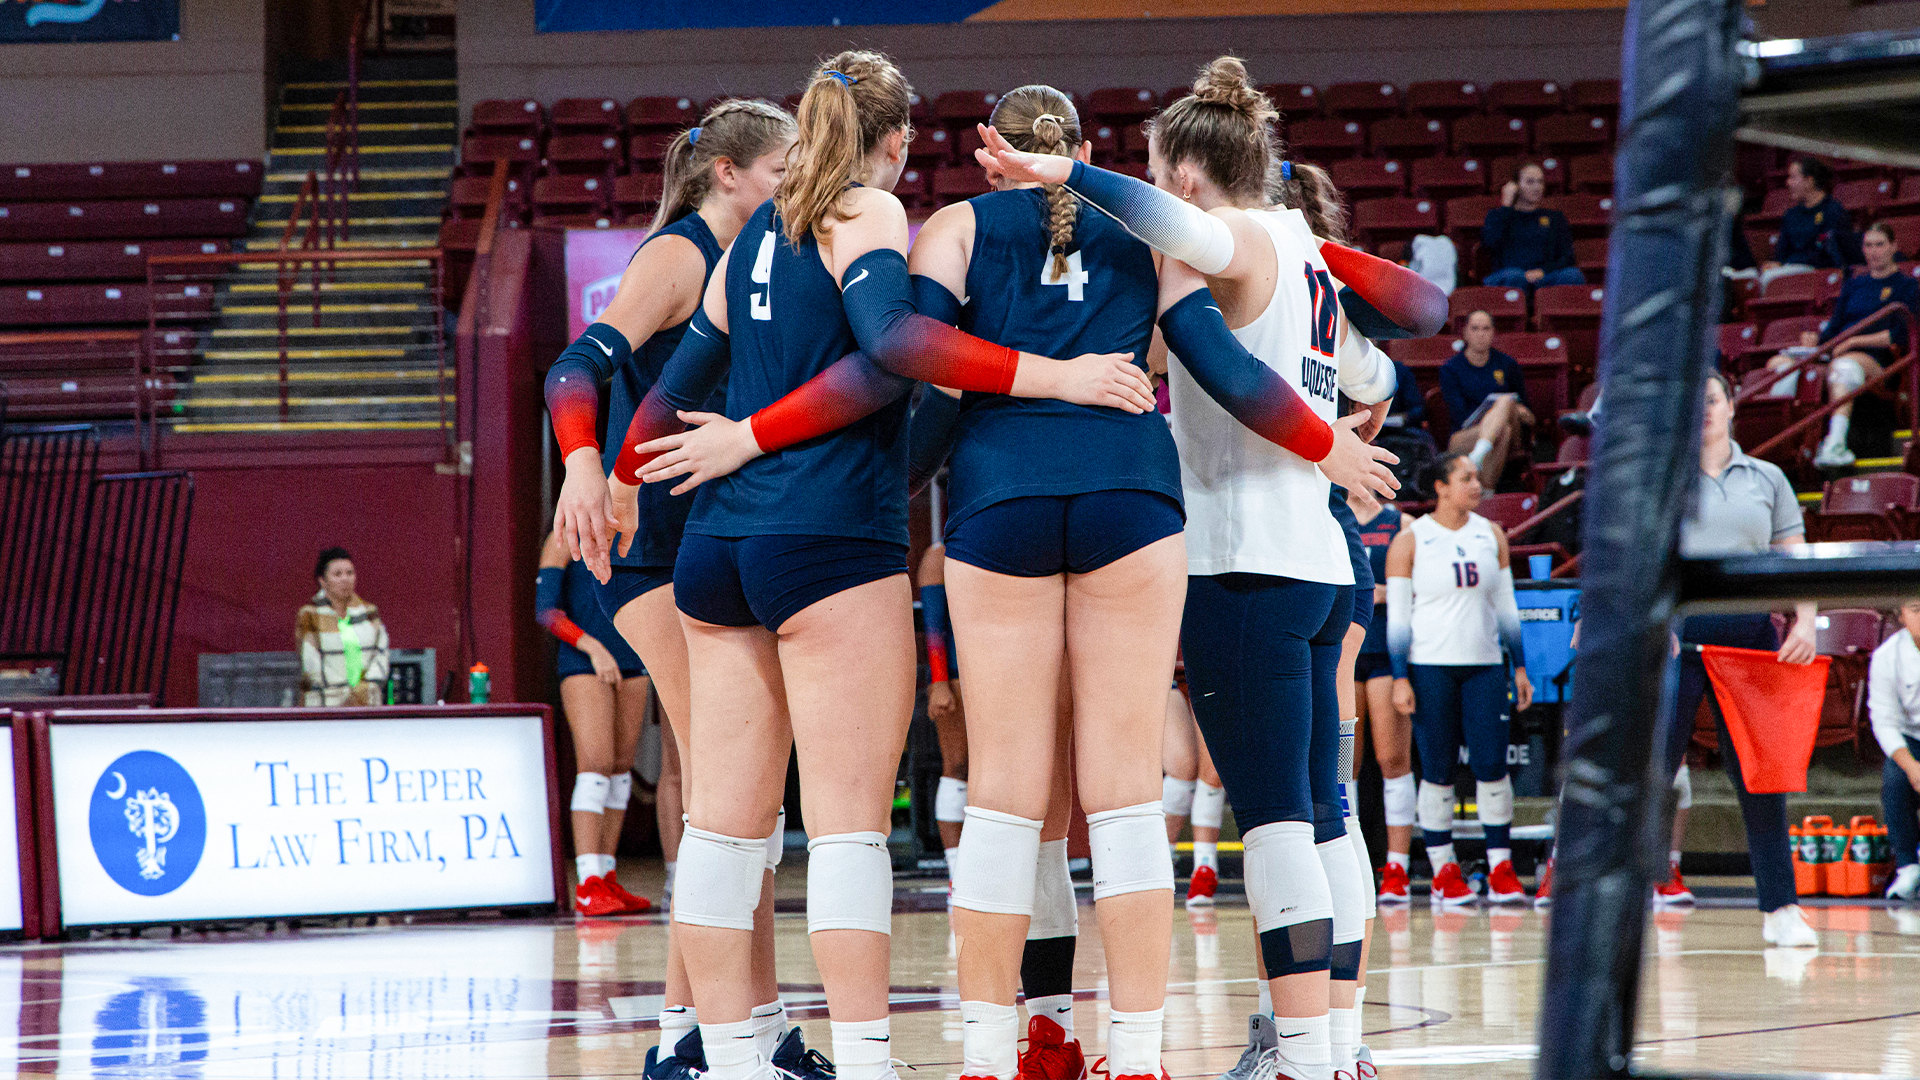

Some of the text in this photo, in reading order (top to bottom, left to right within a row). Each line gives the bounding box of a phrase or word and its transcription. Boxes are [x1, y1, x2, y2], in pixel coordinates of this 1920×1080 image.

[1040, 249, 1089, 301] 4
[1452, 562, 1479, 588] 16
[254, 757, 487, 807] THE PEPER
[227, 812, 522, 872] LAW FIRM, PA
